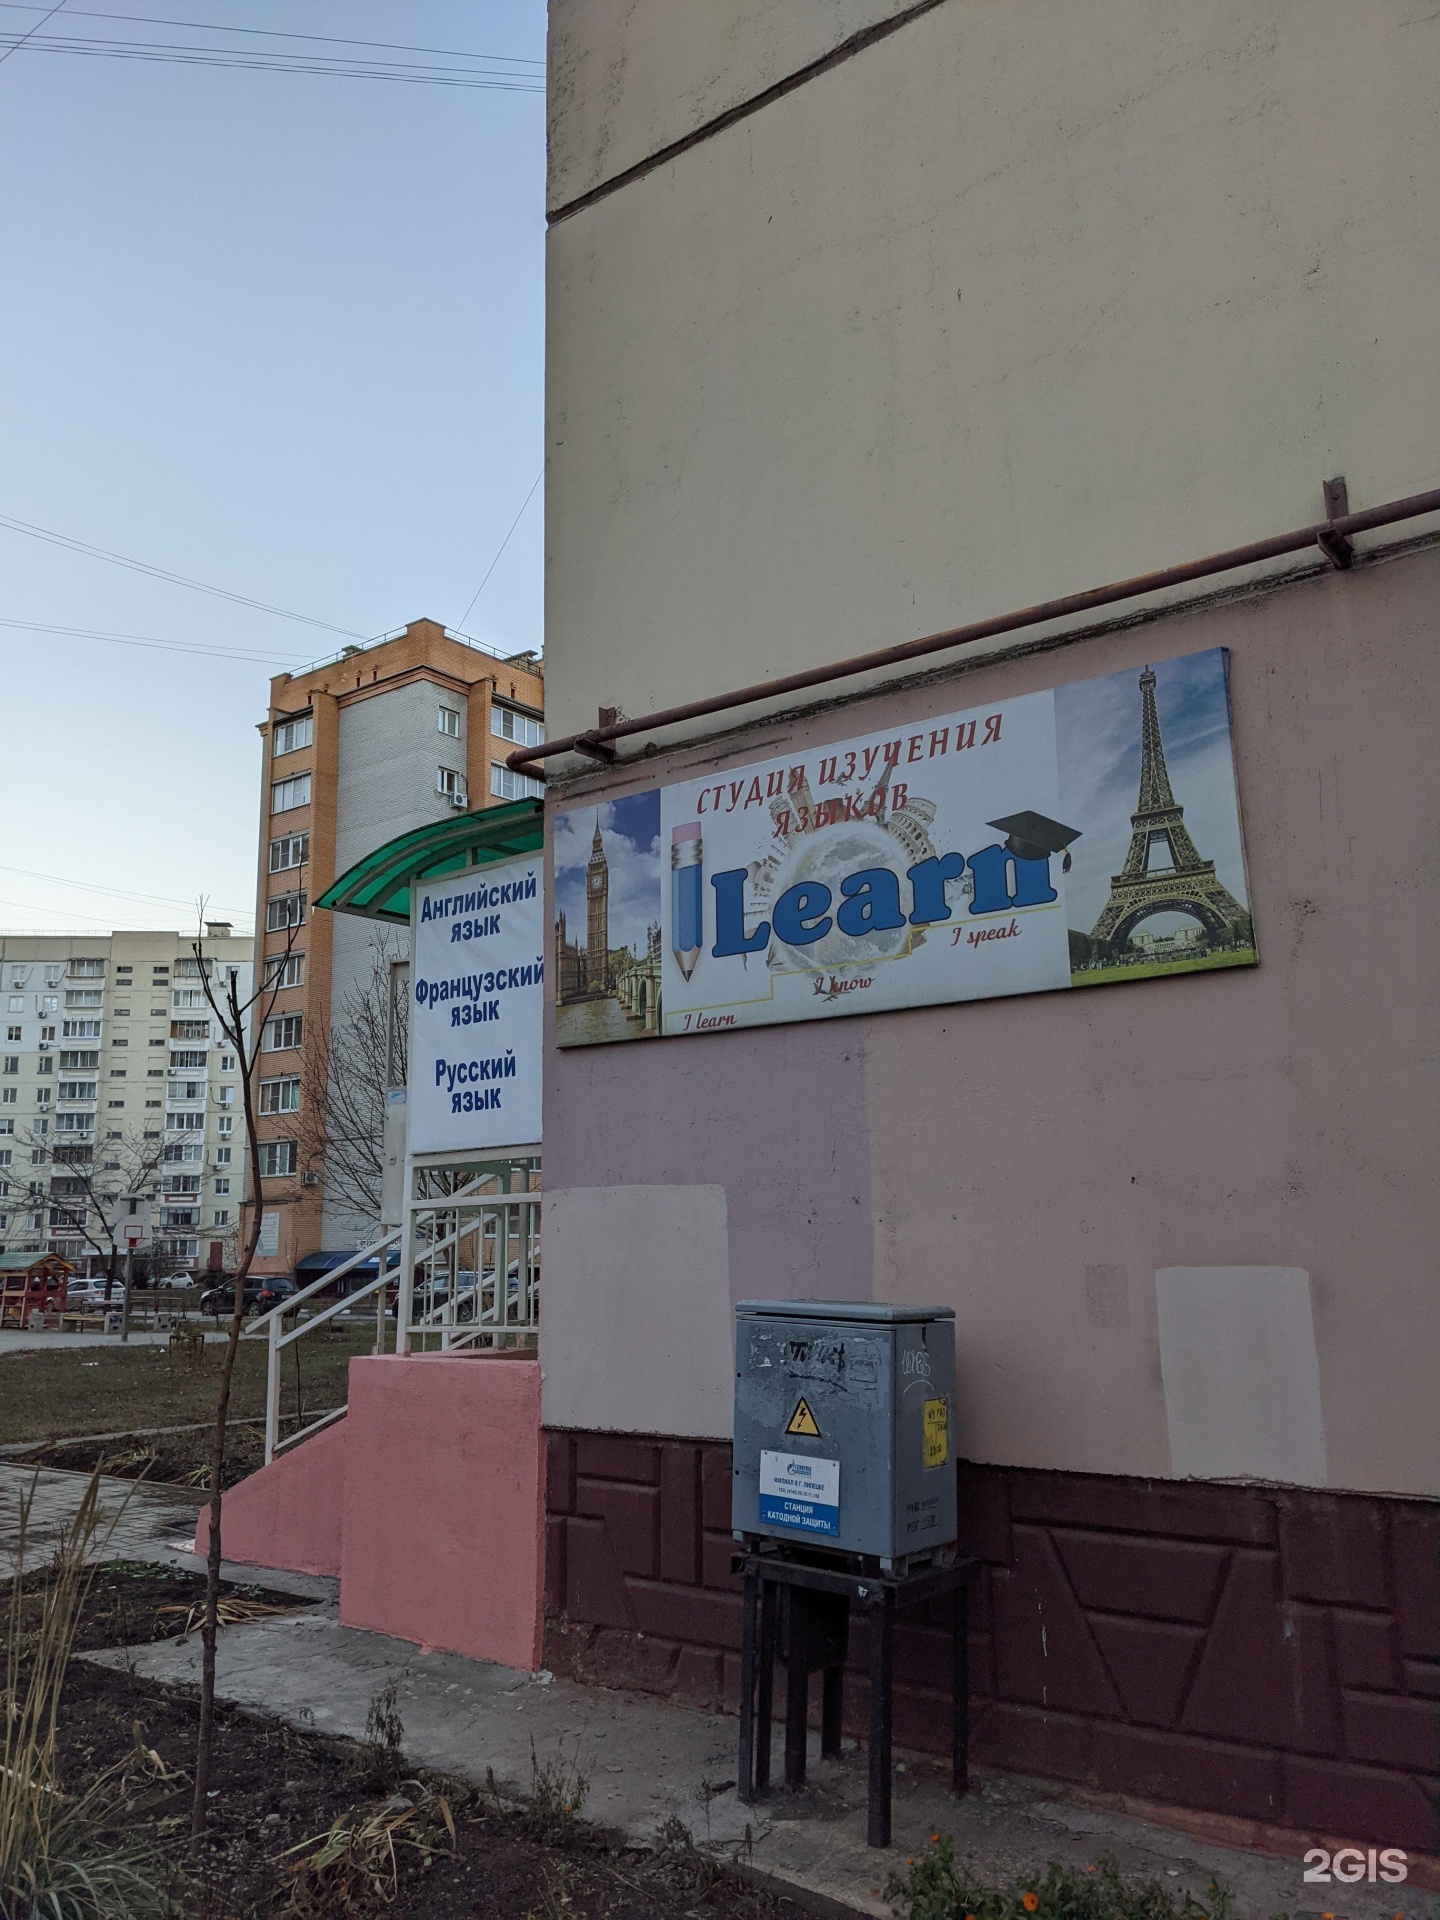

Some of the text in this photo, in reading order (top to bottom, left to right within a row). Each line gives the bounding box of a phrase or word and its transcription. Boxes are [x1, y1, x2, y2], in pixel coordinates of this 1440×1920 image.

[696, 713, 1003, 815] СТУДИЯ ИЗУЧЕНИЯ
[773, 783, 908, 839] ЯЗЫКОВ
[421, 870, 537, 923] Английский
[711, 844, 1058, 958] Learn
[451, 913, 501, 943] язык
[951, 919, 1022, 948] I speak
[415, 955, 543, 1010] Французский
[829, 975, 875, 994] know
[451, 999, 500, 1028] язык
[696, 1013, 737, 1029] learn
[435, 1048, 516, 1092] Русский
[452, 1087, 501, 1114] язык
[774, 1477, 794, 1486] ФИЛИАЛ
[804, 1481, 825, 1490] ЛИПЕЦКЕ
[767, 1510, 831, 1530] КАТОДНОЙ ЗАЩИТЫ
[784, 1501, 813, 1514] СТАНЦИЯ
